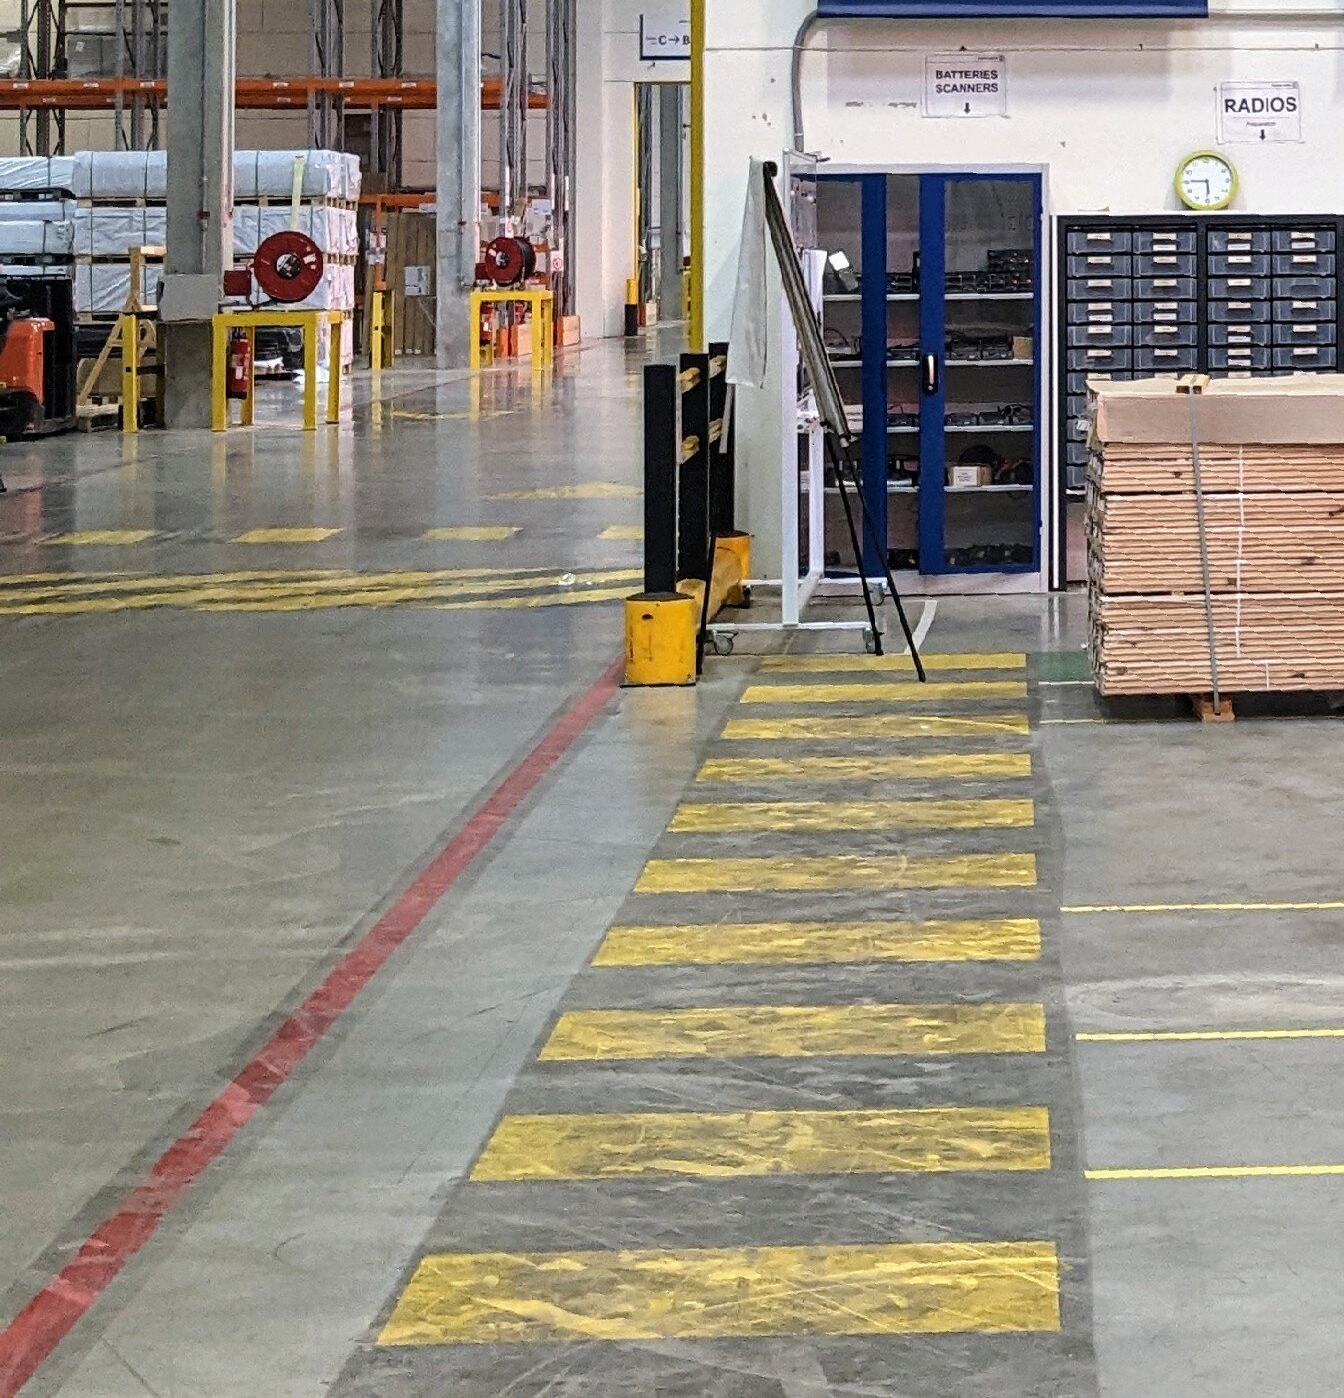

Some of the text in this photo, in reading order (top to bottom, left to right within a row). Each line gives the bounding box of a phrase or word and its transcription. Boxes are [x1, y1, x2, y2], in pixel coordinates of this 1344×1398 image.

[935, 70, 998, 80] BATTERIES
[935, 83, 998, 93] SCANNERS
[1224, 97, 1297, 113] RADIOS
